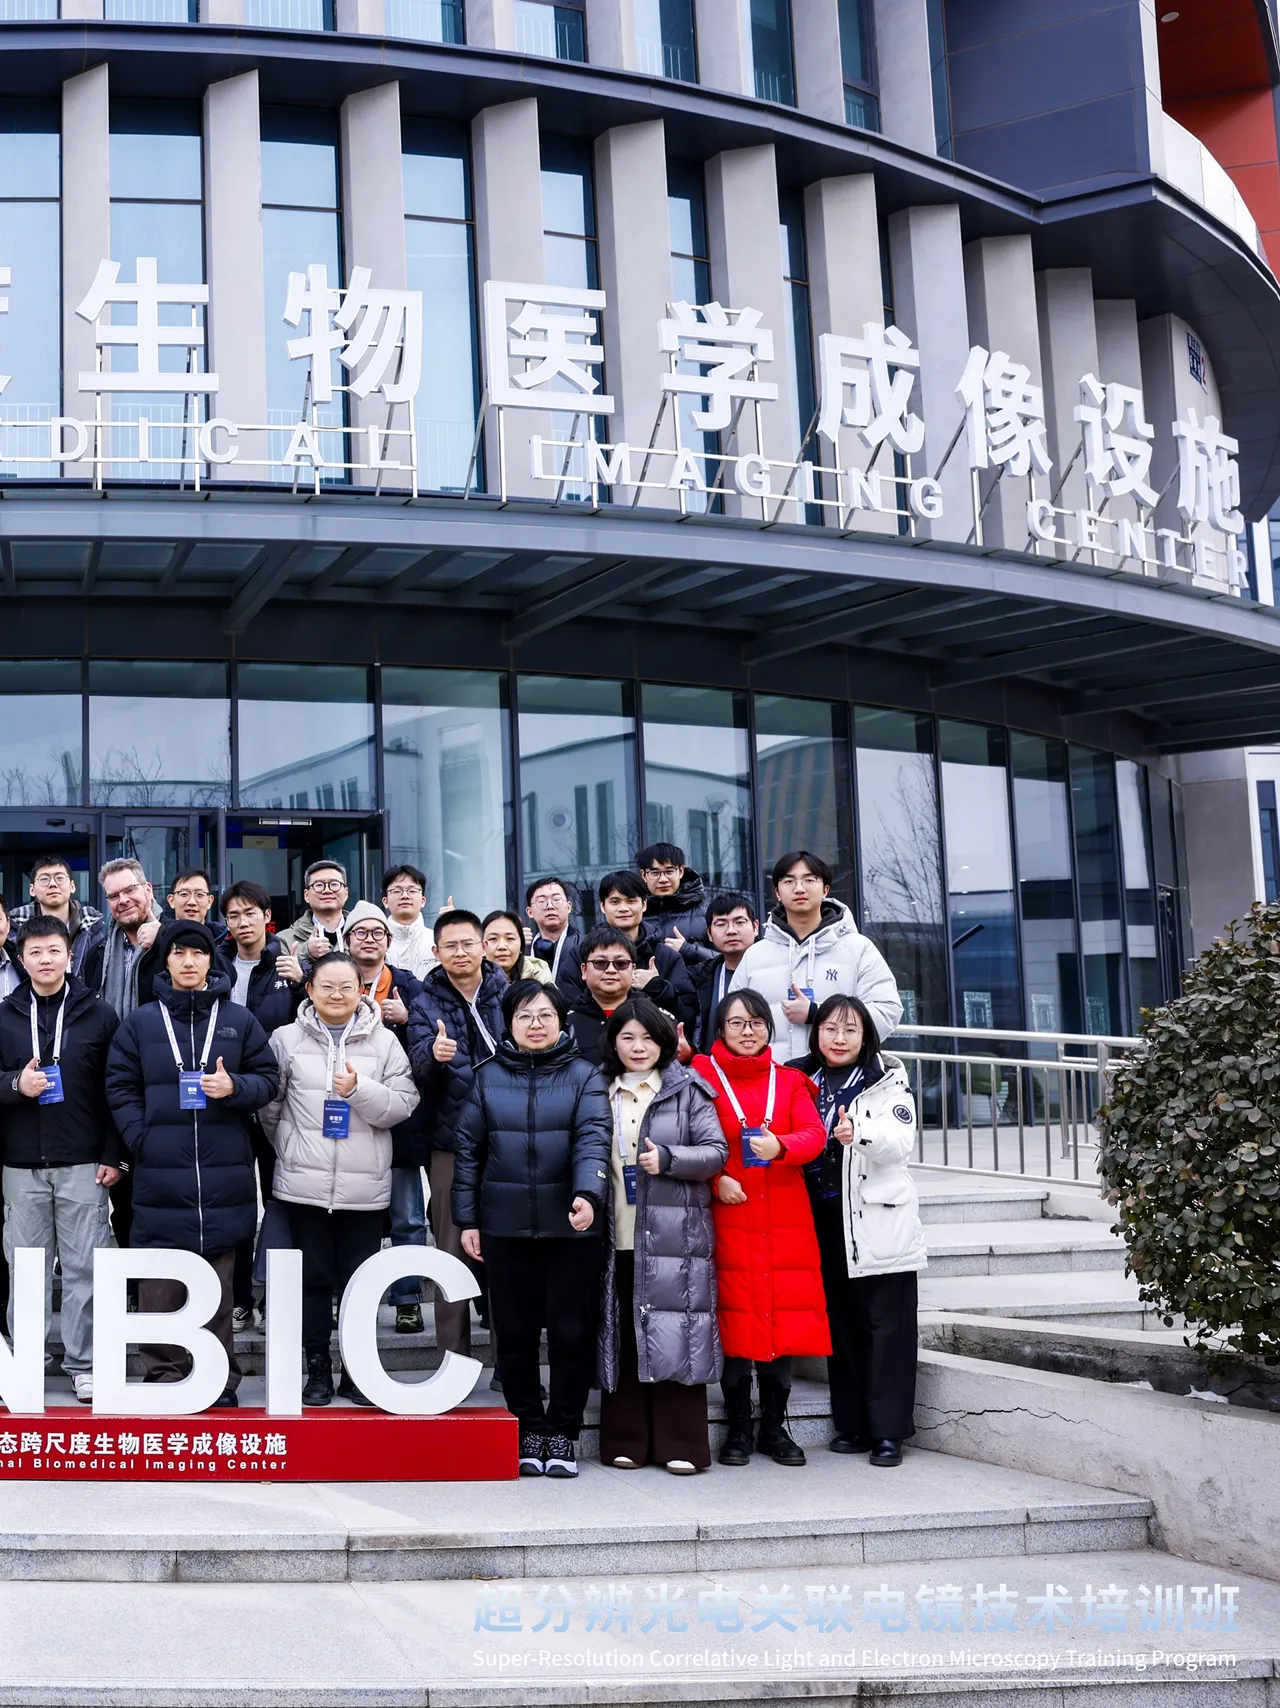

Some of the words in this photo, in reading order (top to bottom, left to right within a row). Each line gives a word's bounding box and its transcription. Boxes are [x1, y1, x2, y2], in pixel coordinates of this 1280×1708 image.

[530, 435, 945, 519] IMAGING
[1027, 498, 1250, 589] CENTER
[33, 1458, 134, 1469] Biomedical
[145, 1459, 216, 1471] Imaging
[227, 1459, 287, 1470] Center
